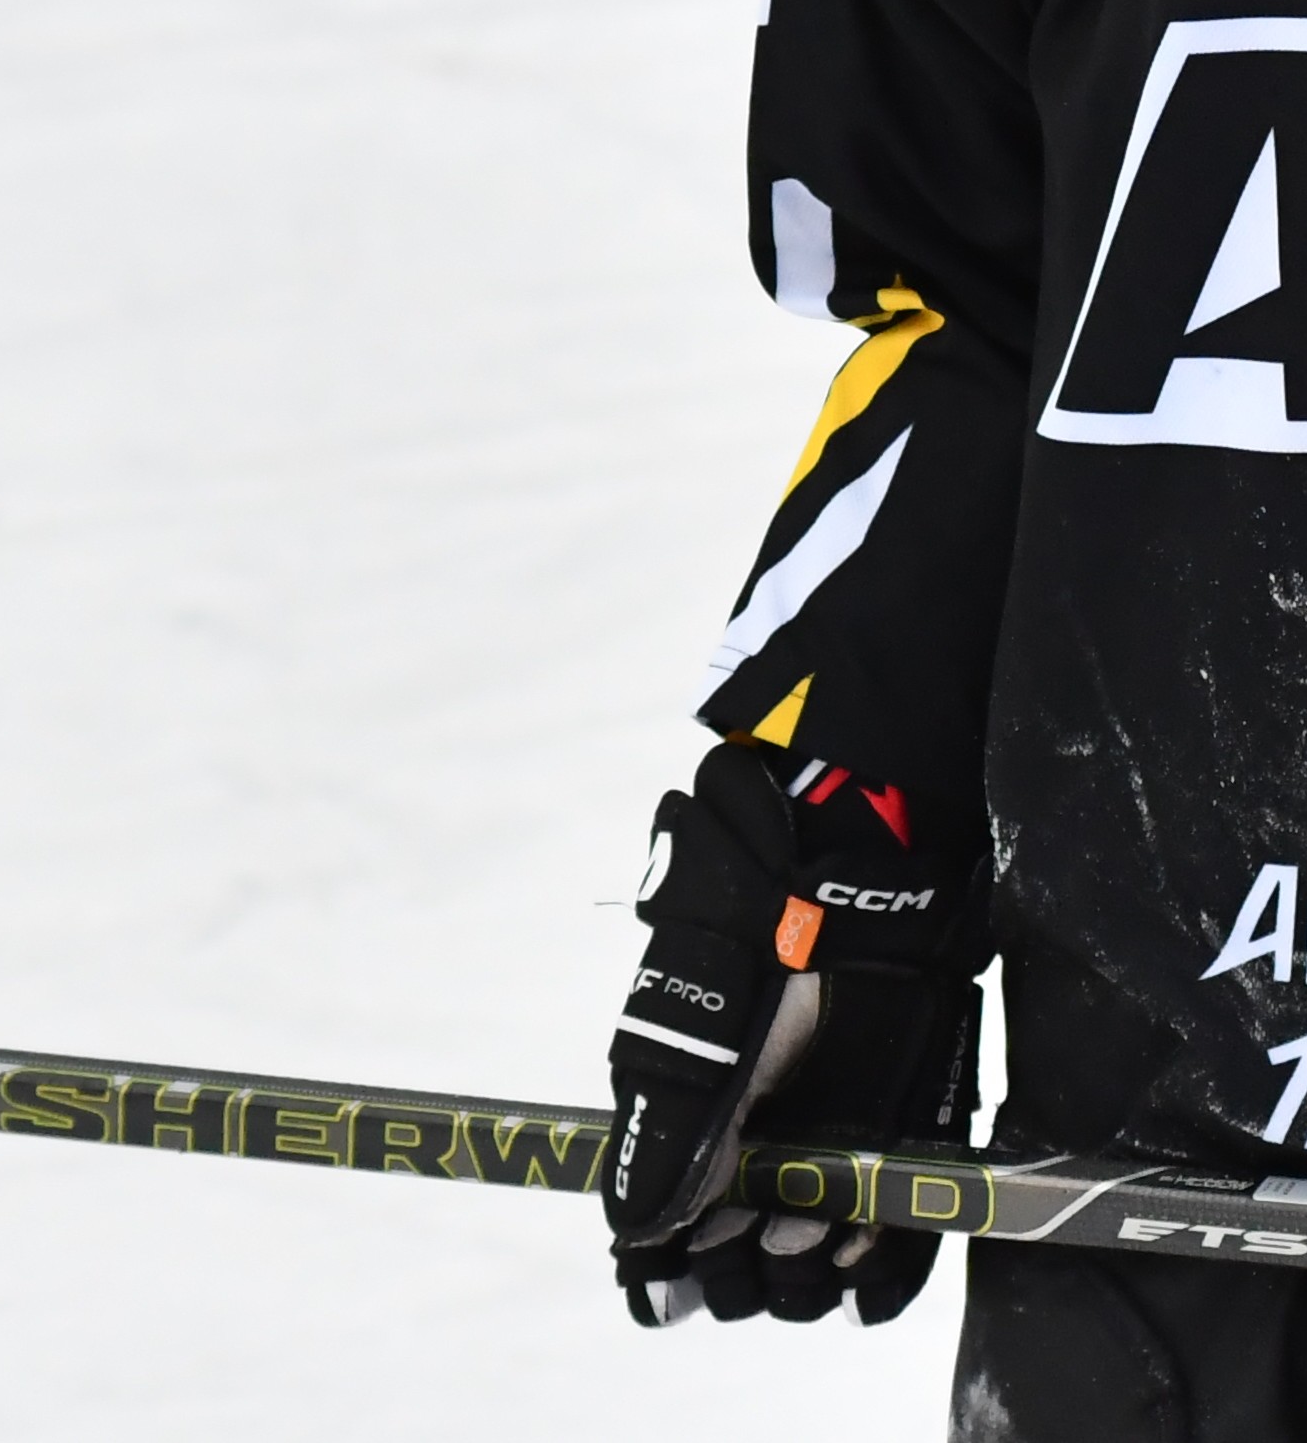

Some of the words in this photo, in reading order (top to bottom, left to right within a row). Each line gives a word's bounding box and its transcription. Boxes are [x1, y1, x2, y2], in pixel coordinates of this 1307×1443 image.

[815, 880, 937, 913] CCM
[663, 976, 726, 1013] PRO
[0, 1067, 996, 1236] SHERWOD
[616, 1092, 649, 1202] CCM
